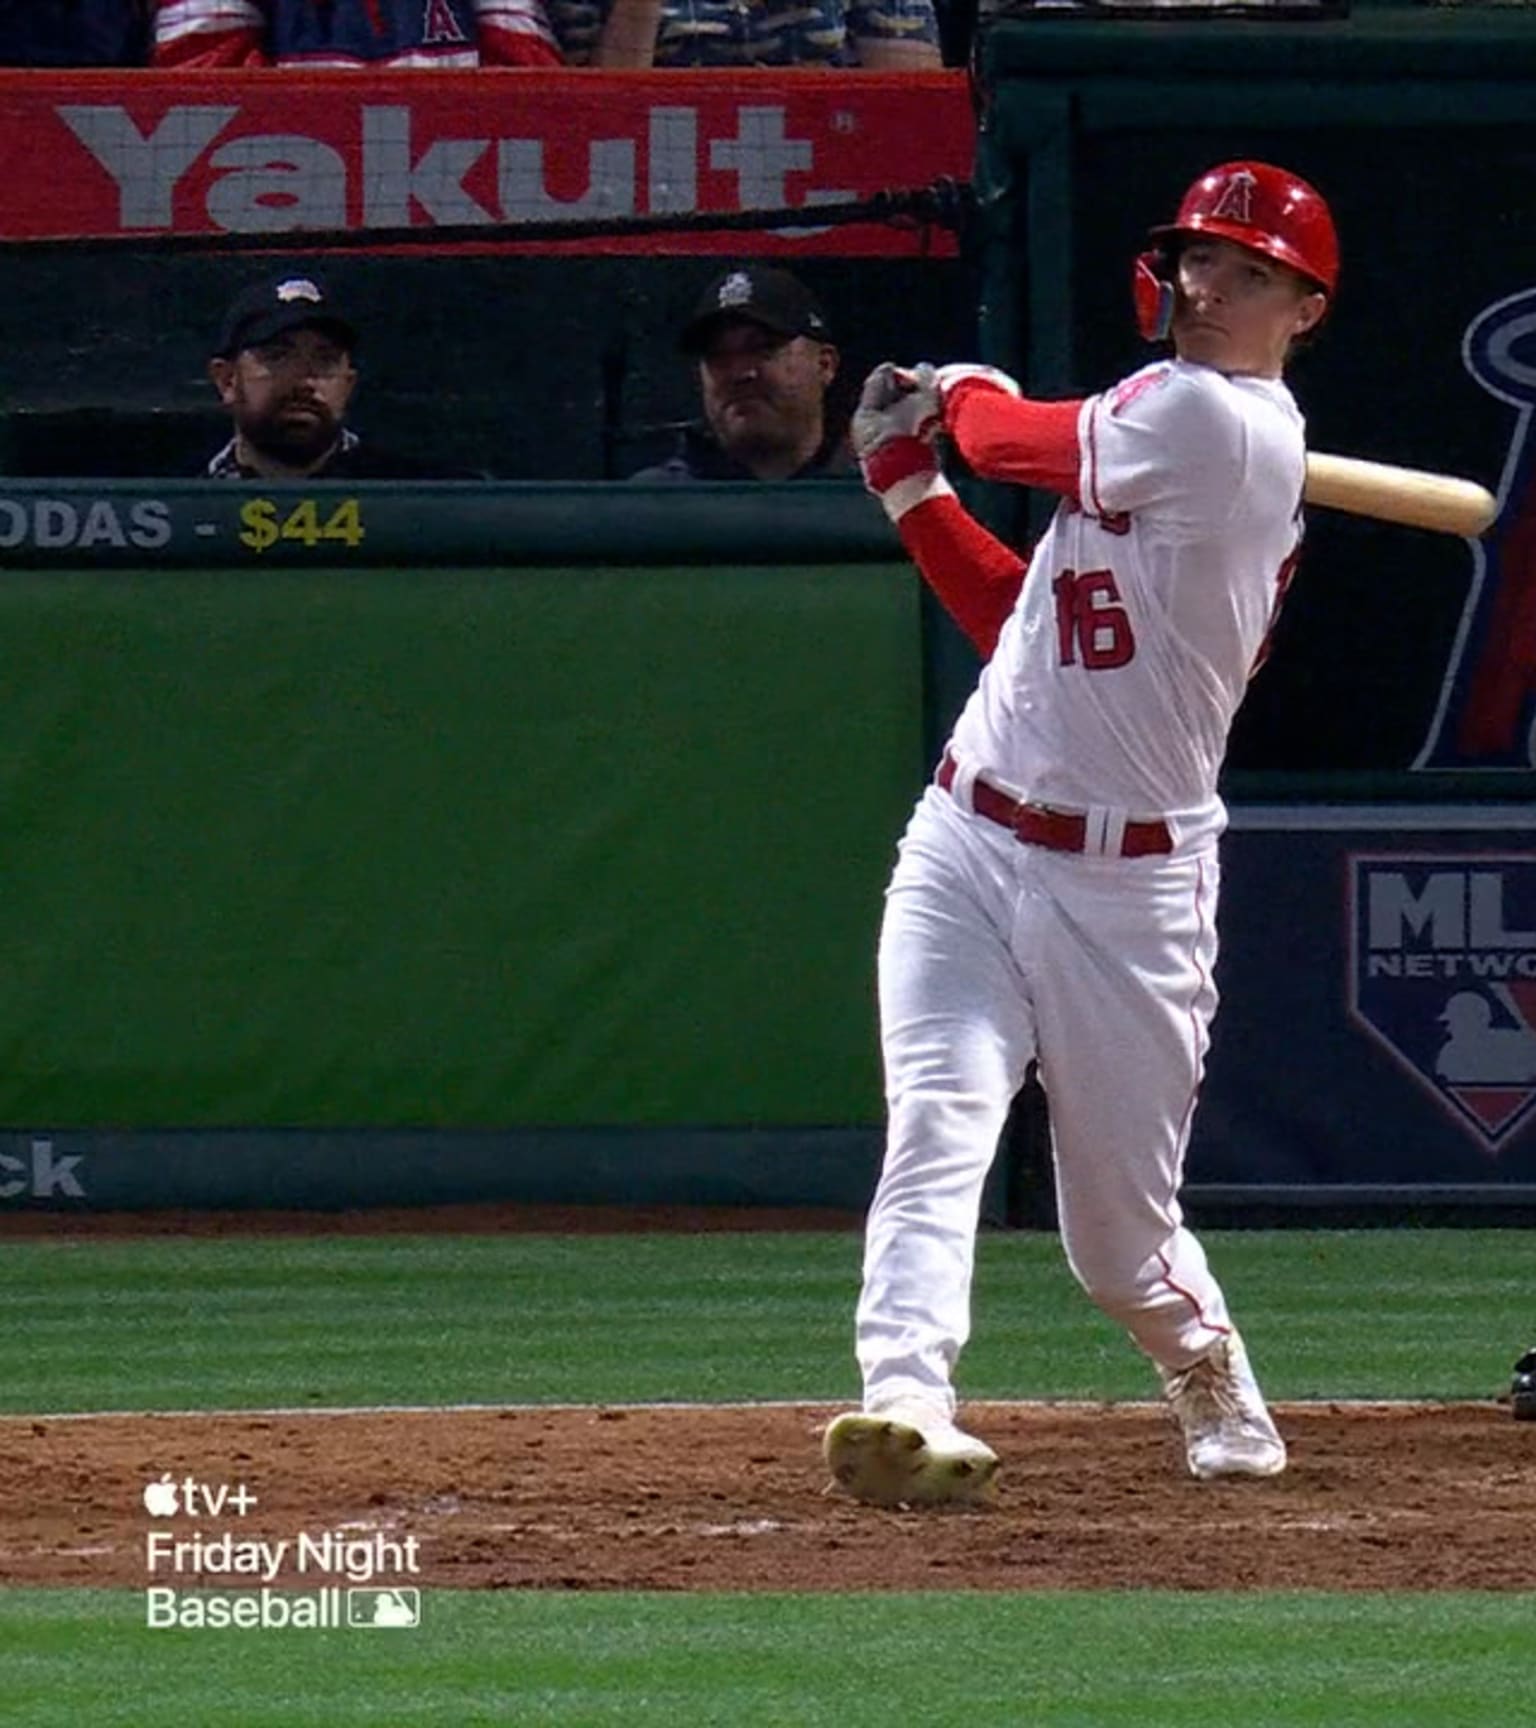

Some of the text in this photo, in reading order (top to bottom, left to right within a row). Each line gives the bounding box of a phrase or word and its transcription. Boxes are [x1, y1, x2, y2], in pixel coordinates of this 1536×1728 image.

[421, 0, 470, 43] A
[57, 104, 860, 238] Yakult
[1211, 170, 1258, 223] A
[239, 499, 365, 552] $44
[1052, 568, 1136, 671] 16
